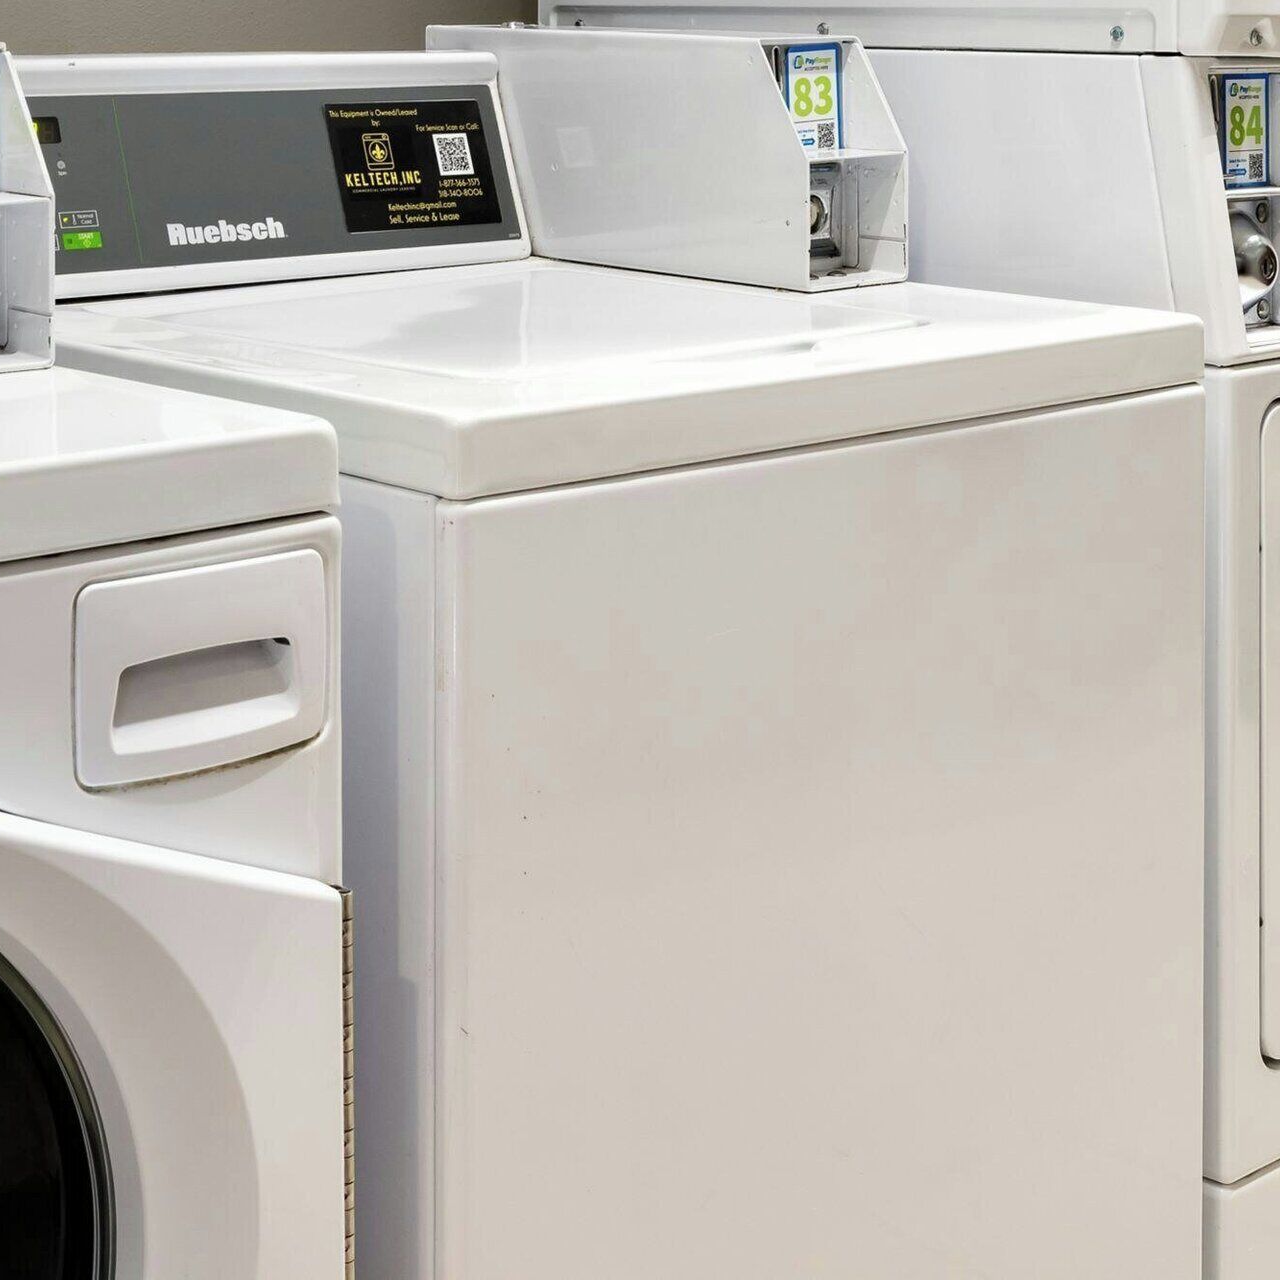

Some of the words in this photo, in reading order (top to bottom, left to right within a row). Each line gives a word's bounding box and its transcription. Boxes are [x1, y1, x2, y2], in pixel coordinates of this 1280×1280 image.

[340, 110, 369, 118] Equipment
[794, 75, 833, 117] 83
[1229, 105, 1264, 146] 84
